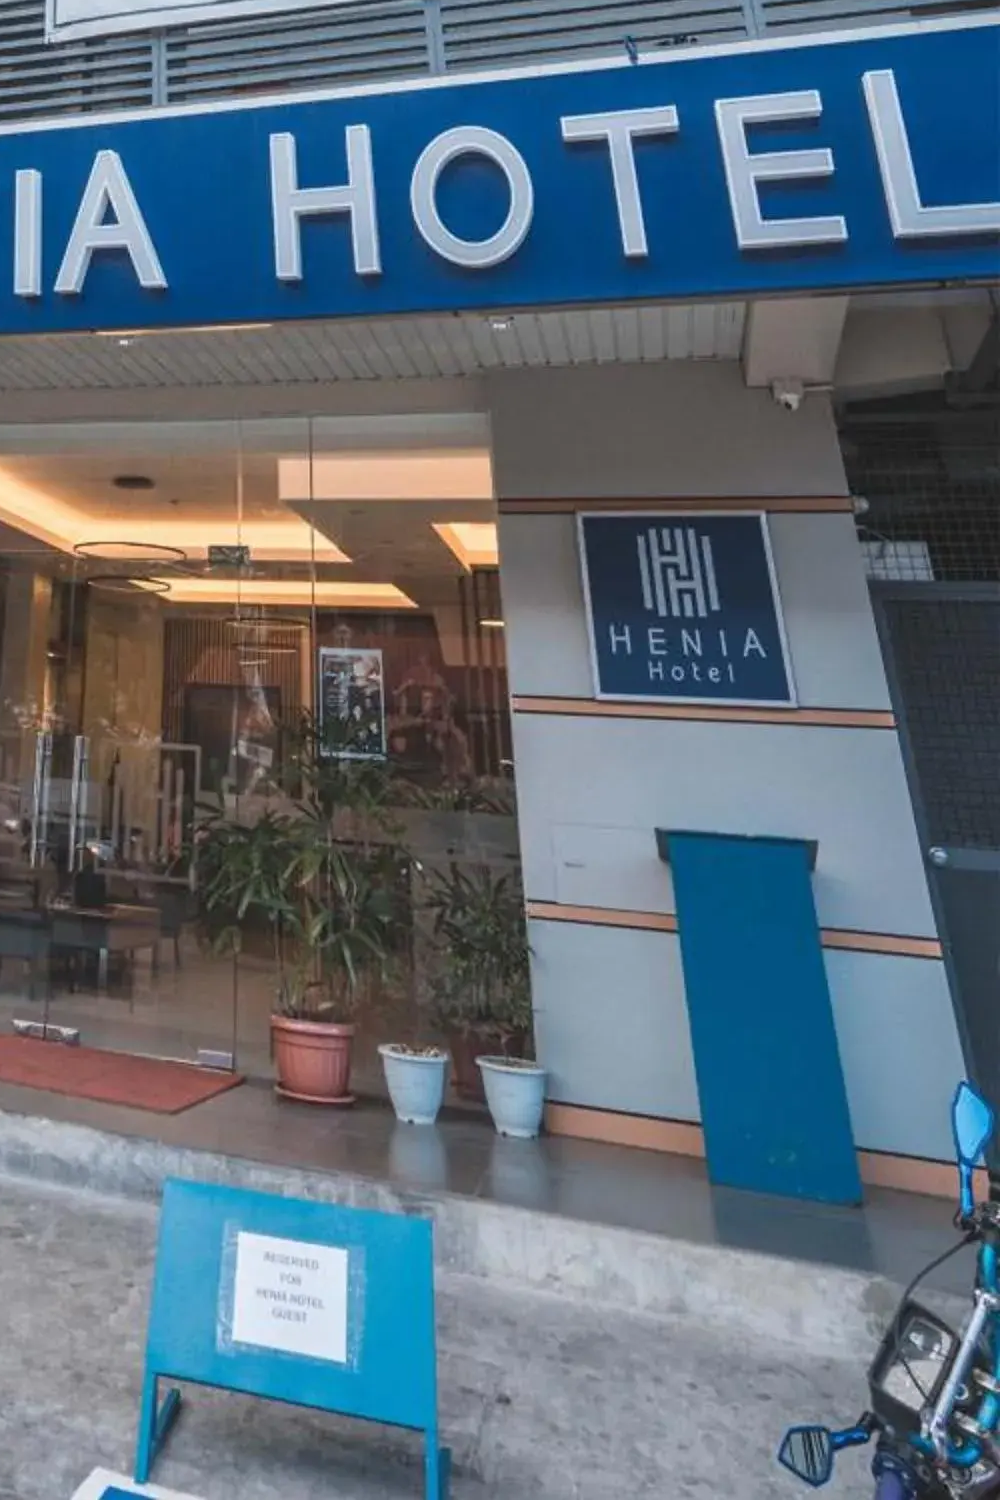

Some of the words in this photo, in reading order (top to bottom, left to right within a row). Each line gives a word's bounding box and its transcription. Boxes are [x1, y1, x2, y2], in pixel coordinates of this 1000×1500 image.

[269, 69, 1000, 280] HOTEL
[609, 624, 767, 659] HENIA
[649, 661, 735, 684] Hotel
